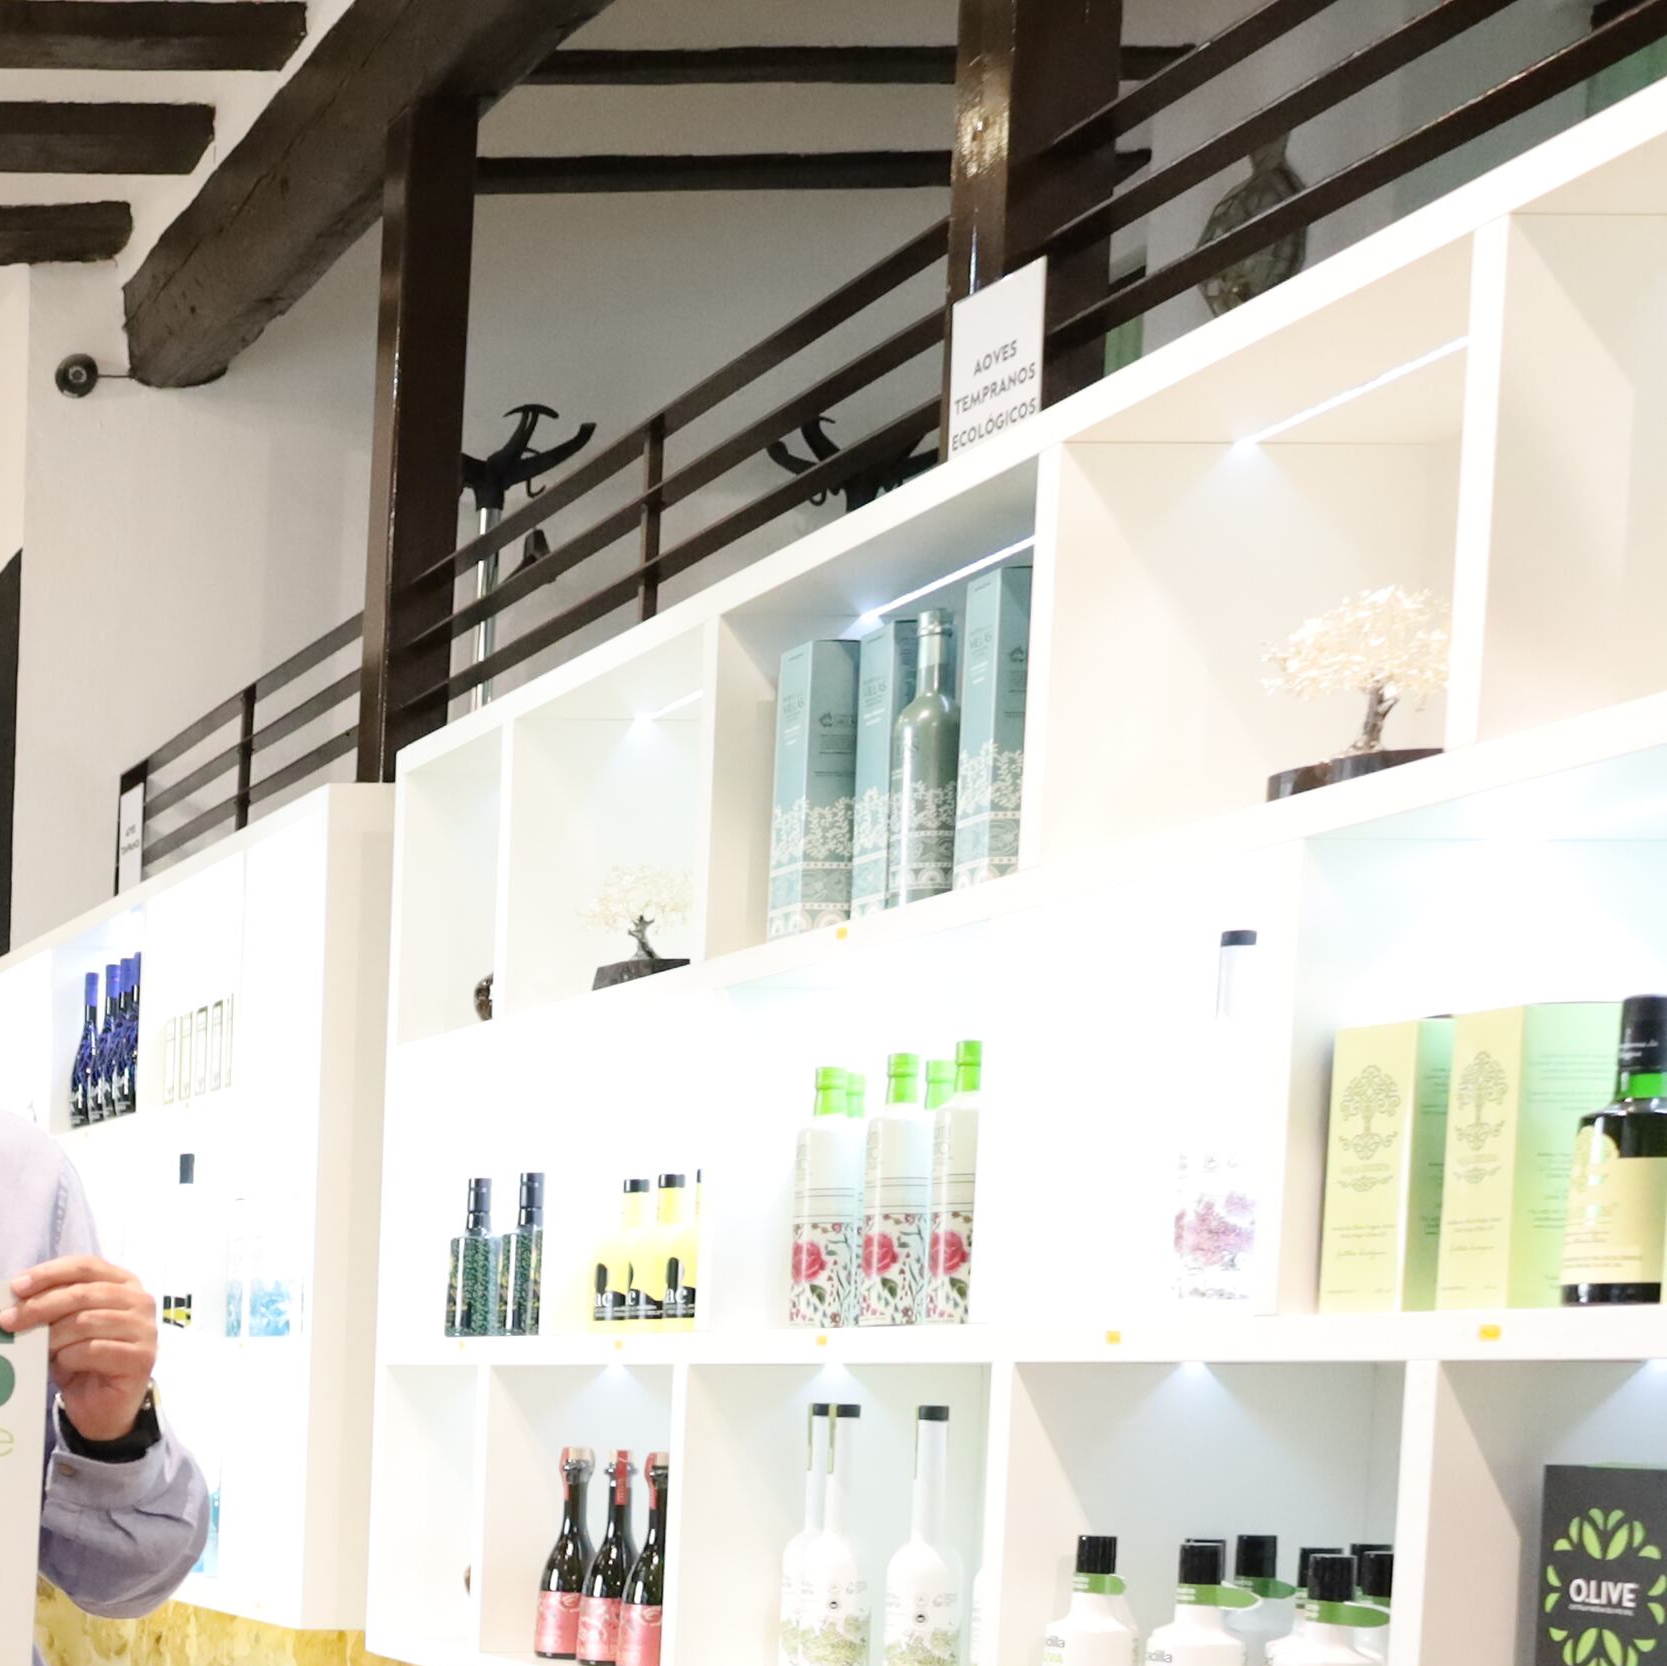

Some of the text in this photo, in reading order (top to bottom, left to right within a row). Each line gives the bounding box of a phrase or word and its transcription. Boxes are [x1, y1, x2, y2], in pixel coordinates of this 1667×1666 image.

[973, 339, 1018, 377] AOVES
[954, 361, 1036, 416] TEMPRANOS
[951, 398, 1037, 452] ECOLÓGICOS
